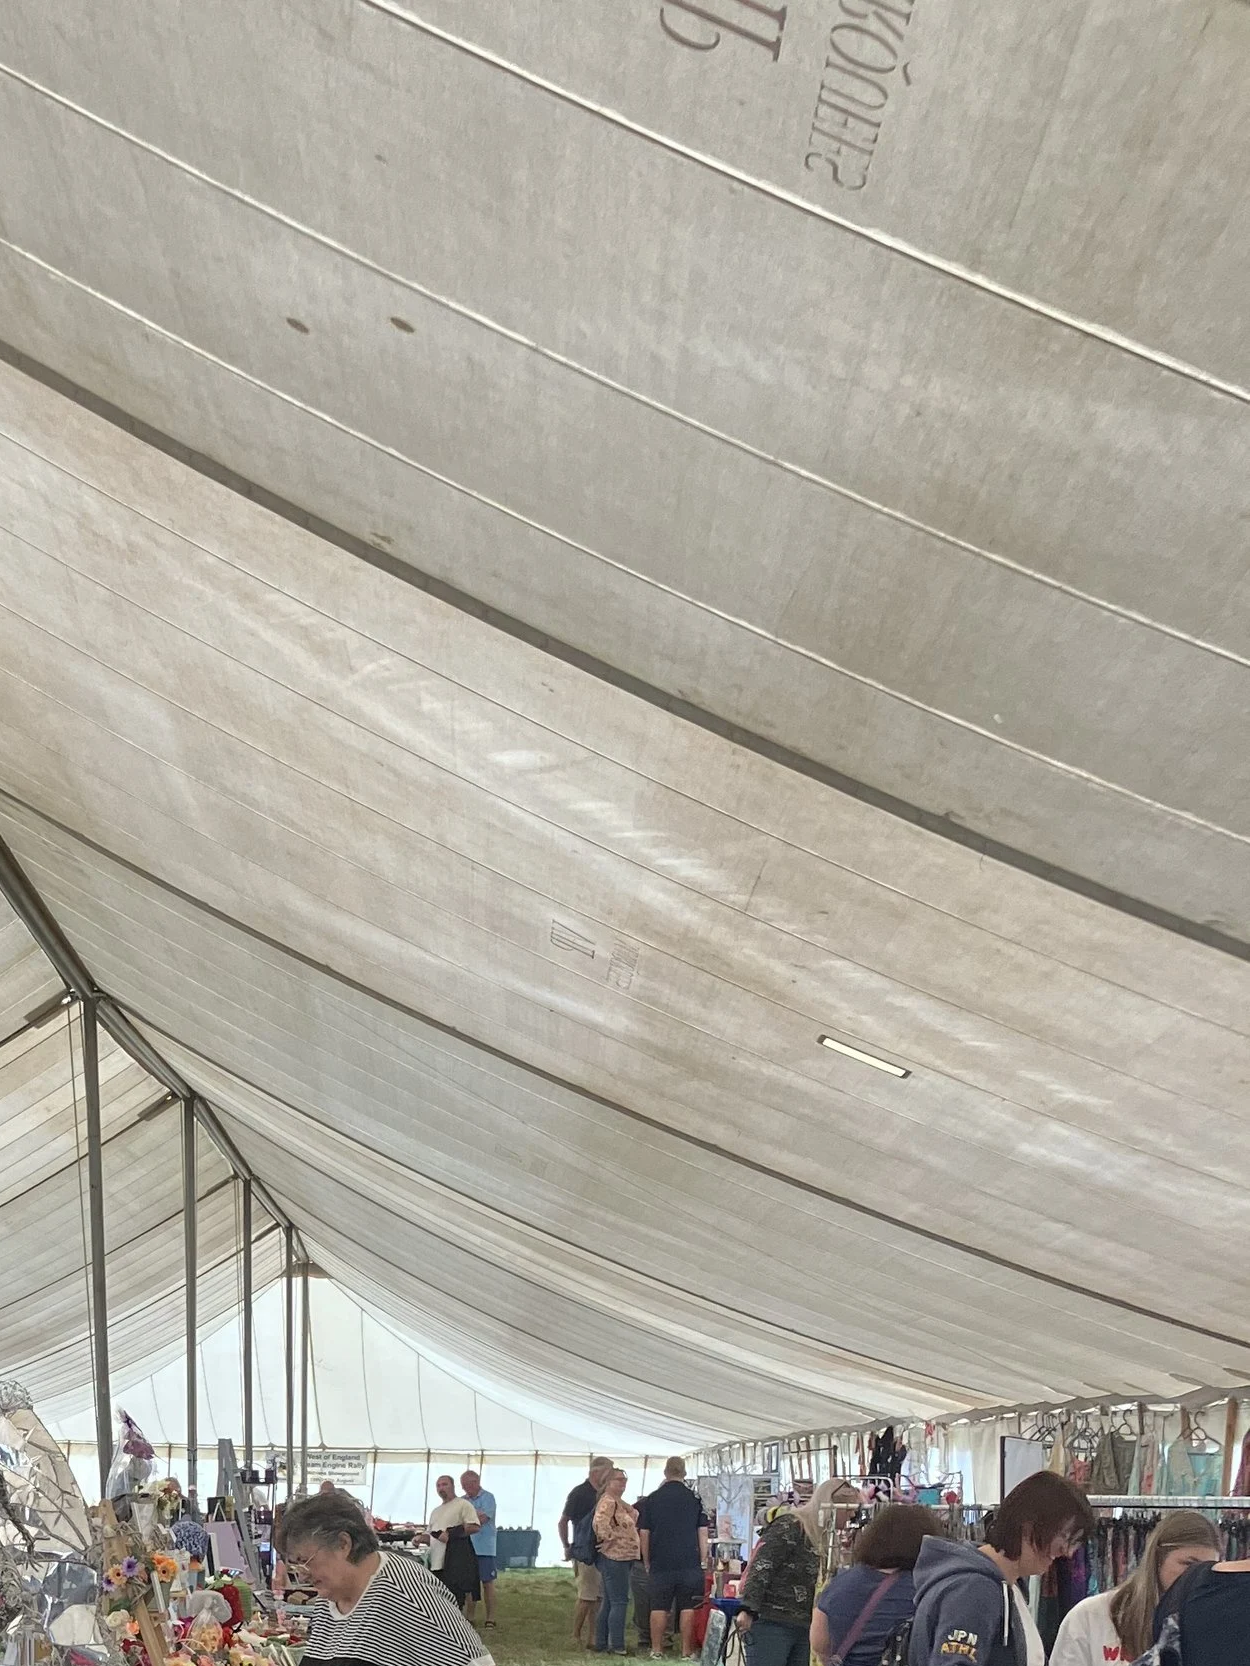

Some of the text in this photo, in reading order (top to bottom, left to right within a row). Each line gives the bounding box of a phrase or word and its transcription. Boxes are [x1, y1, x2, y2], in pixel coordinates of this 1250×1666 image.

[332, 1453, 361, 1462] England
[322, 1461, 346, 1470] Engine
[348, 1462, 366, 1470] Rally
[947, 1629, 978, 1646] JPN
